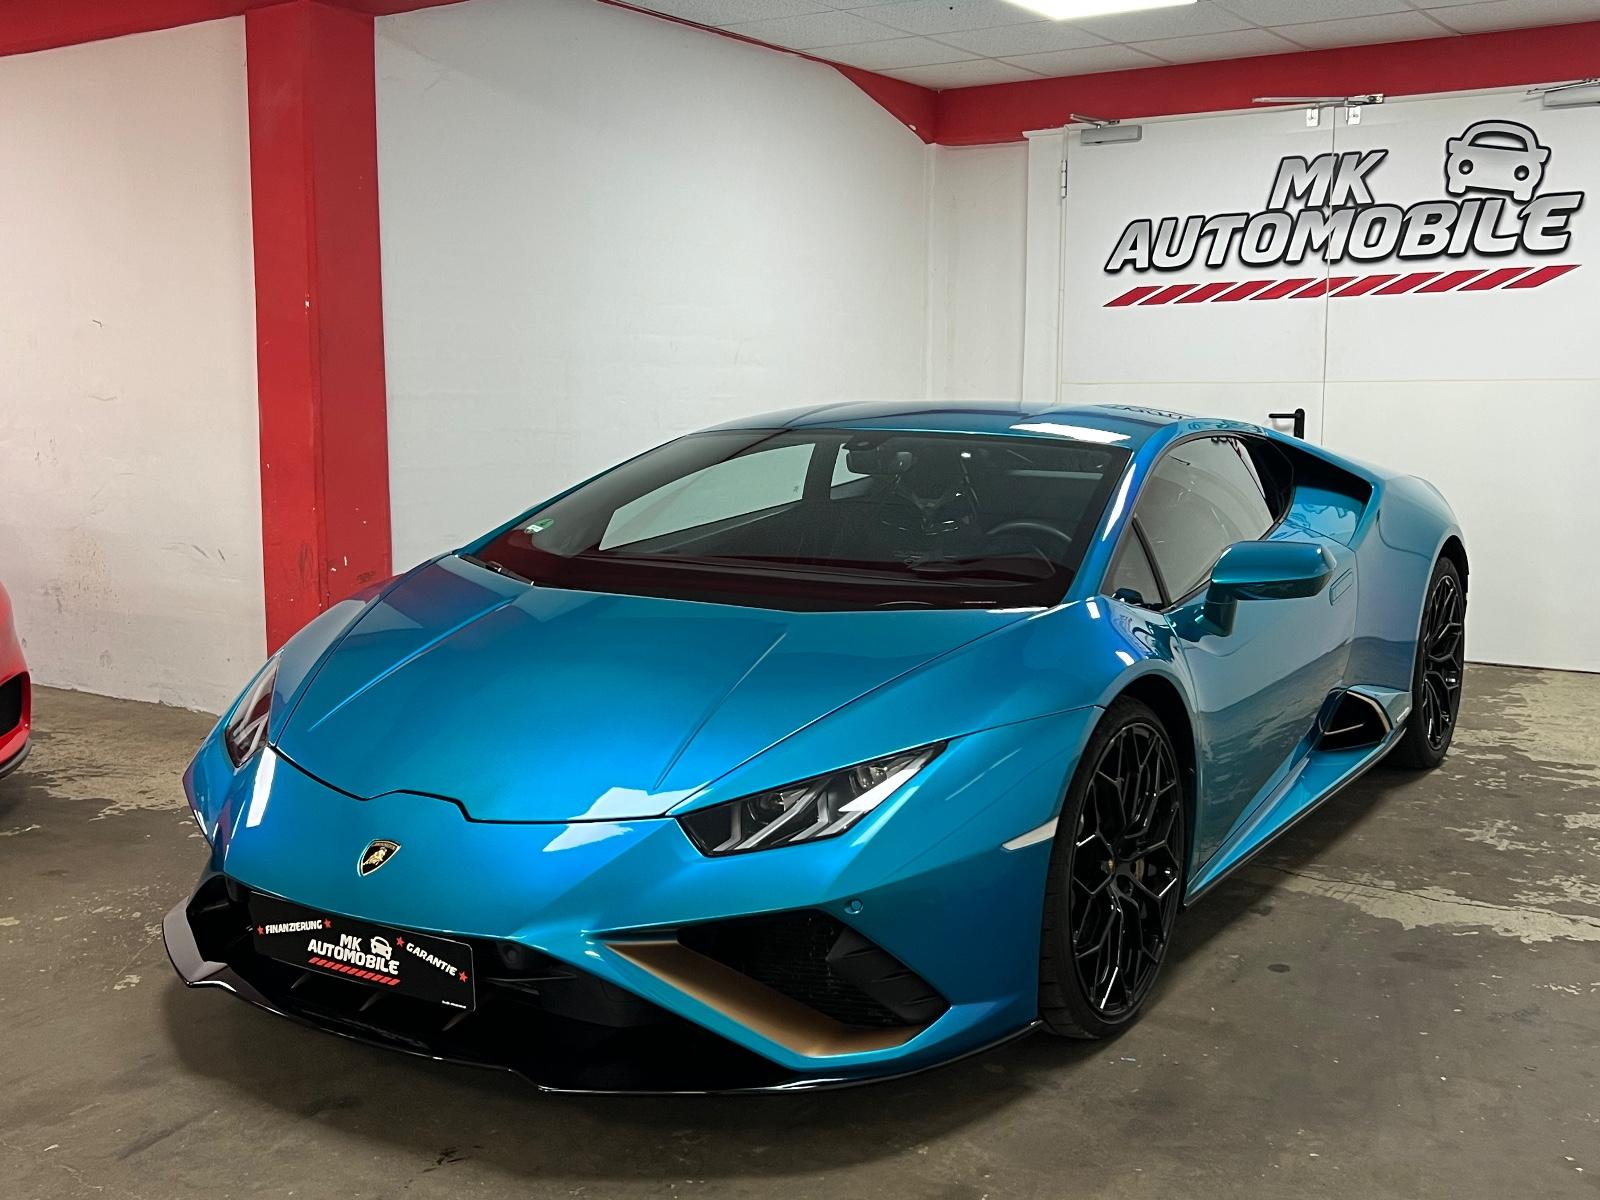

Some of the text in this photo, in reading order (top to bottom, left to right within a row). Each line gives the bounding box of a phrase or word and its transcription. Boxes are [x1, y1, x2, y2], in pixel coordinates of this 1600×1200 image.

[1266, 149, 1389, 210] MK
[1103, 191, 1585, 274] AUTOMOBILE
[265, 919, 323, 935] FINANZIERUNG
[340, 933, 362, 951] MK
[307, 938, 400, 975] AUTOMOBILE
[406, 942, 458, 977] GARANTIE
